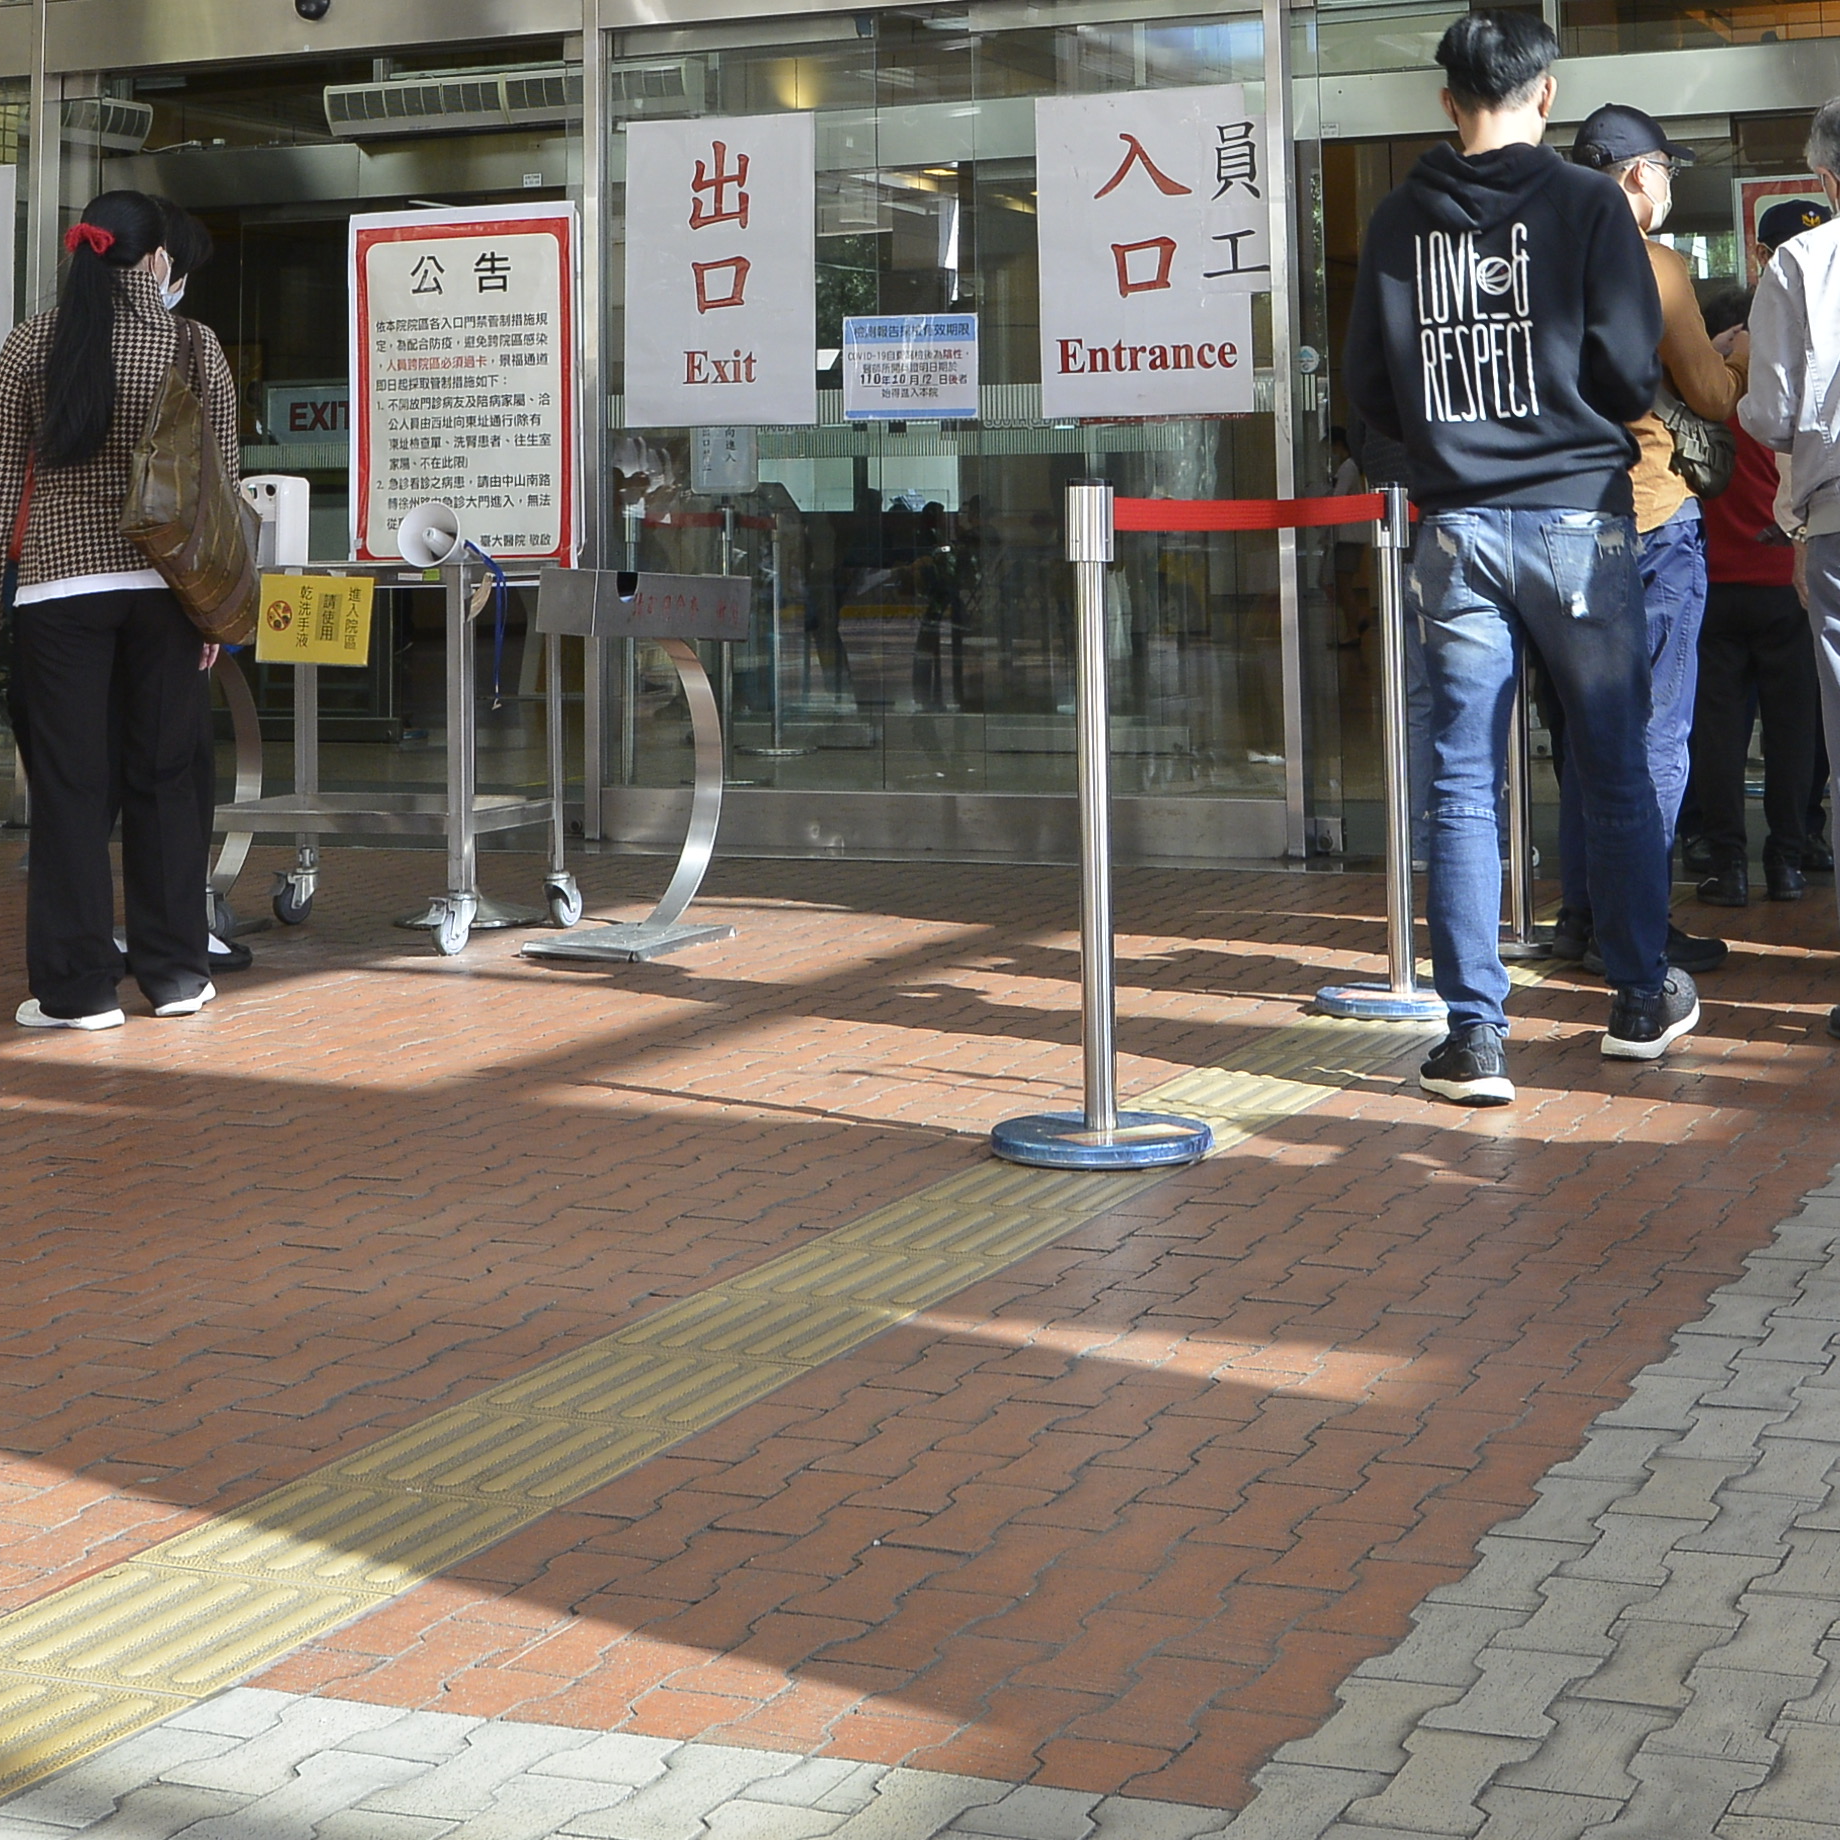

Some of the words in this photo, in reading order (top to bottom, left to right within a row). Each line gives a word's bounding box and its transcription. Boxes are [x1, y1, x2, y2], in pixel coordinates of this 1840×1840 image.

[687, 140, 752, 316] 出口
[1093, 132, 1193, 300] 入口
[1203, 121, 1271, 279] 員工
[409, 251, 512, 296] 公告
[1414, 230, 1488, 325] LOVE
[682, 348, 757, 387] Exit
[1055, 337, 1239, 377] Entrance
[1420, 318, 1540, 425] RESPECT
[295, 585, 314, 649] 乾洗手液
[319, 594, 337, 641] 請使用
[343, 586, 362, 650] 進入院區
